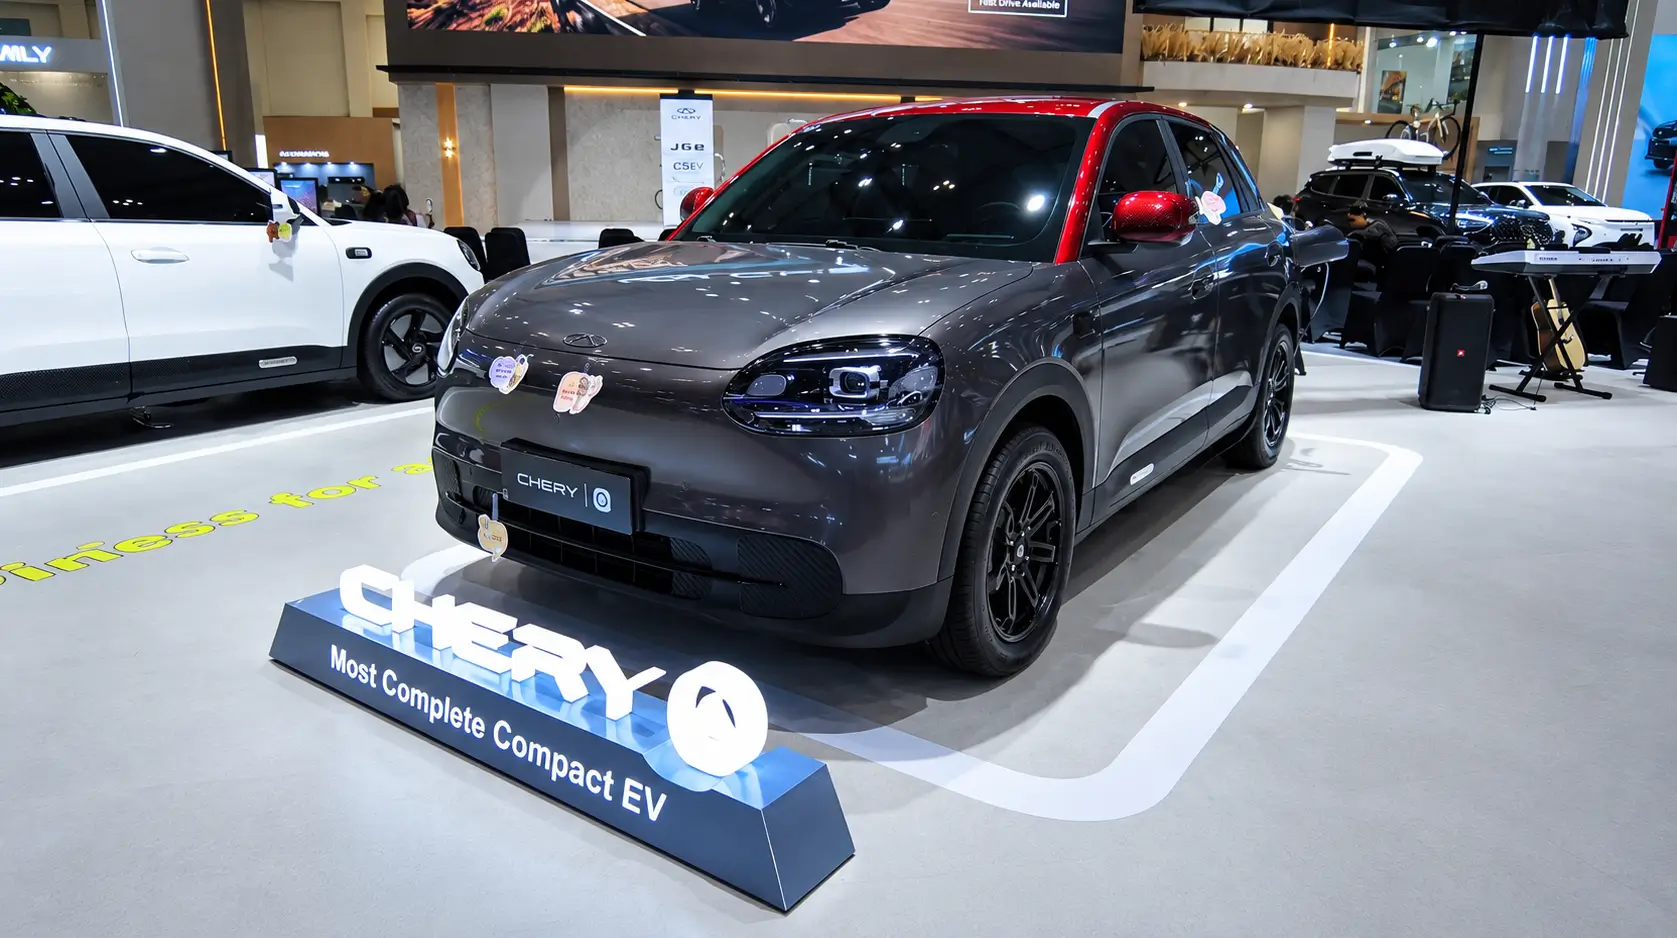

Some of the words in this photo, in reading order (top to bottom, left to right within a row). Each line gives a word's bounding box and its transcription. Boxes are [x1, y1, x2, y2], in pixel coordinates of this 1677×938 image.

[998, 0, 1021, 8] Drive
[0, 509, 260, 585] iness
[269, 474, 382, 509] for
[391, 457, 433, 475] a
[517, 472, 578, 498] CHERY
[339, 564, 667, 722] CHERY
[330, 644, 377, 689] Most
[382, 669, 486, 739] Complete
[493, 720, 614, 802] Compact
[622, 777, 667, 822] EV
